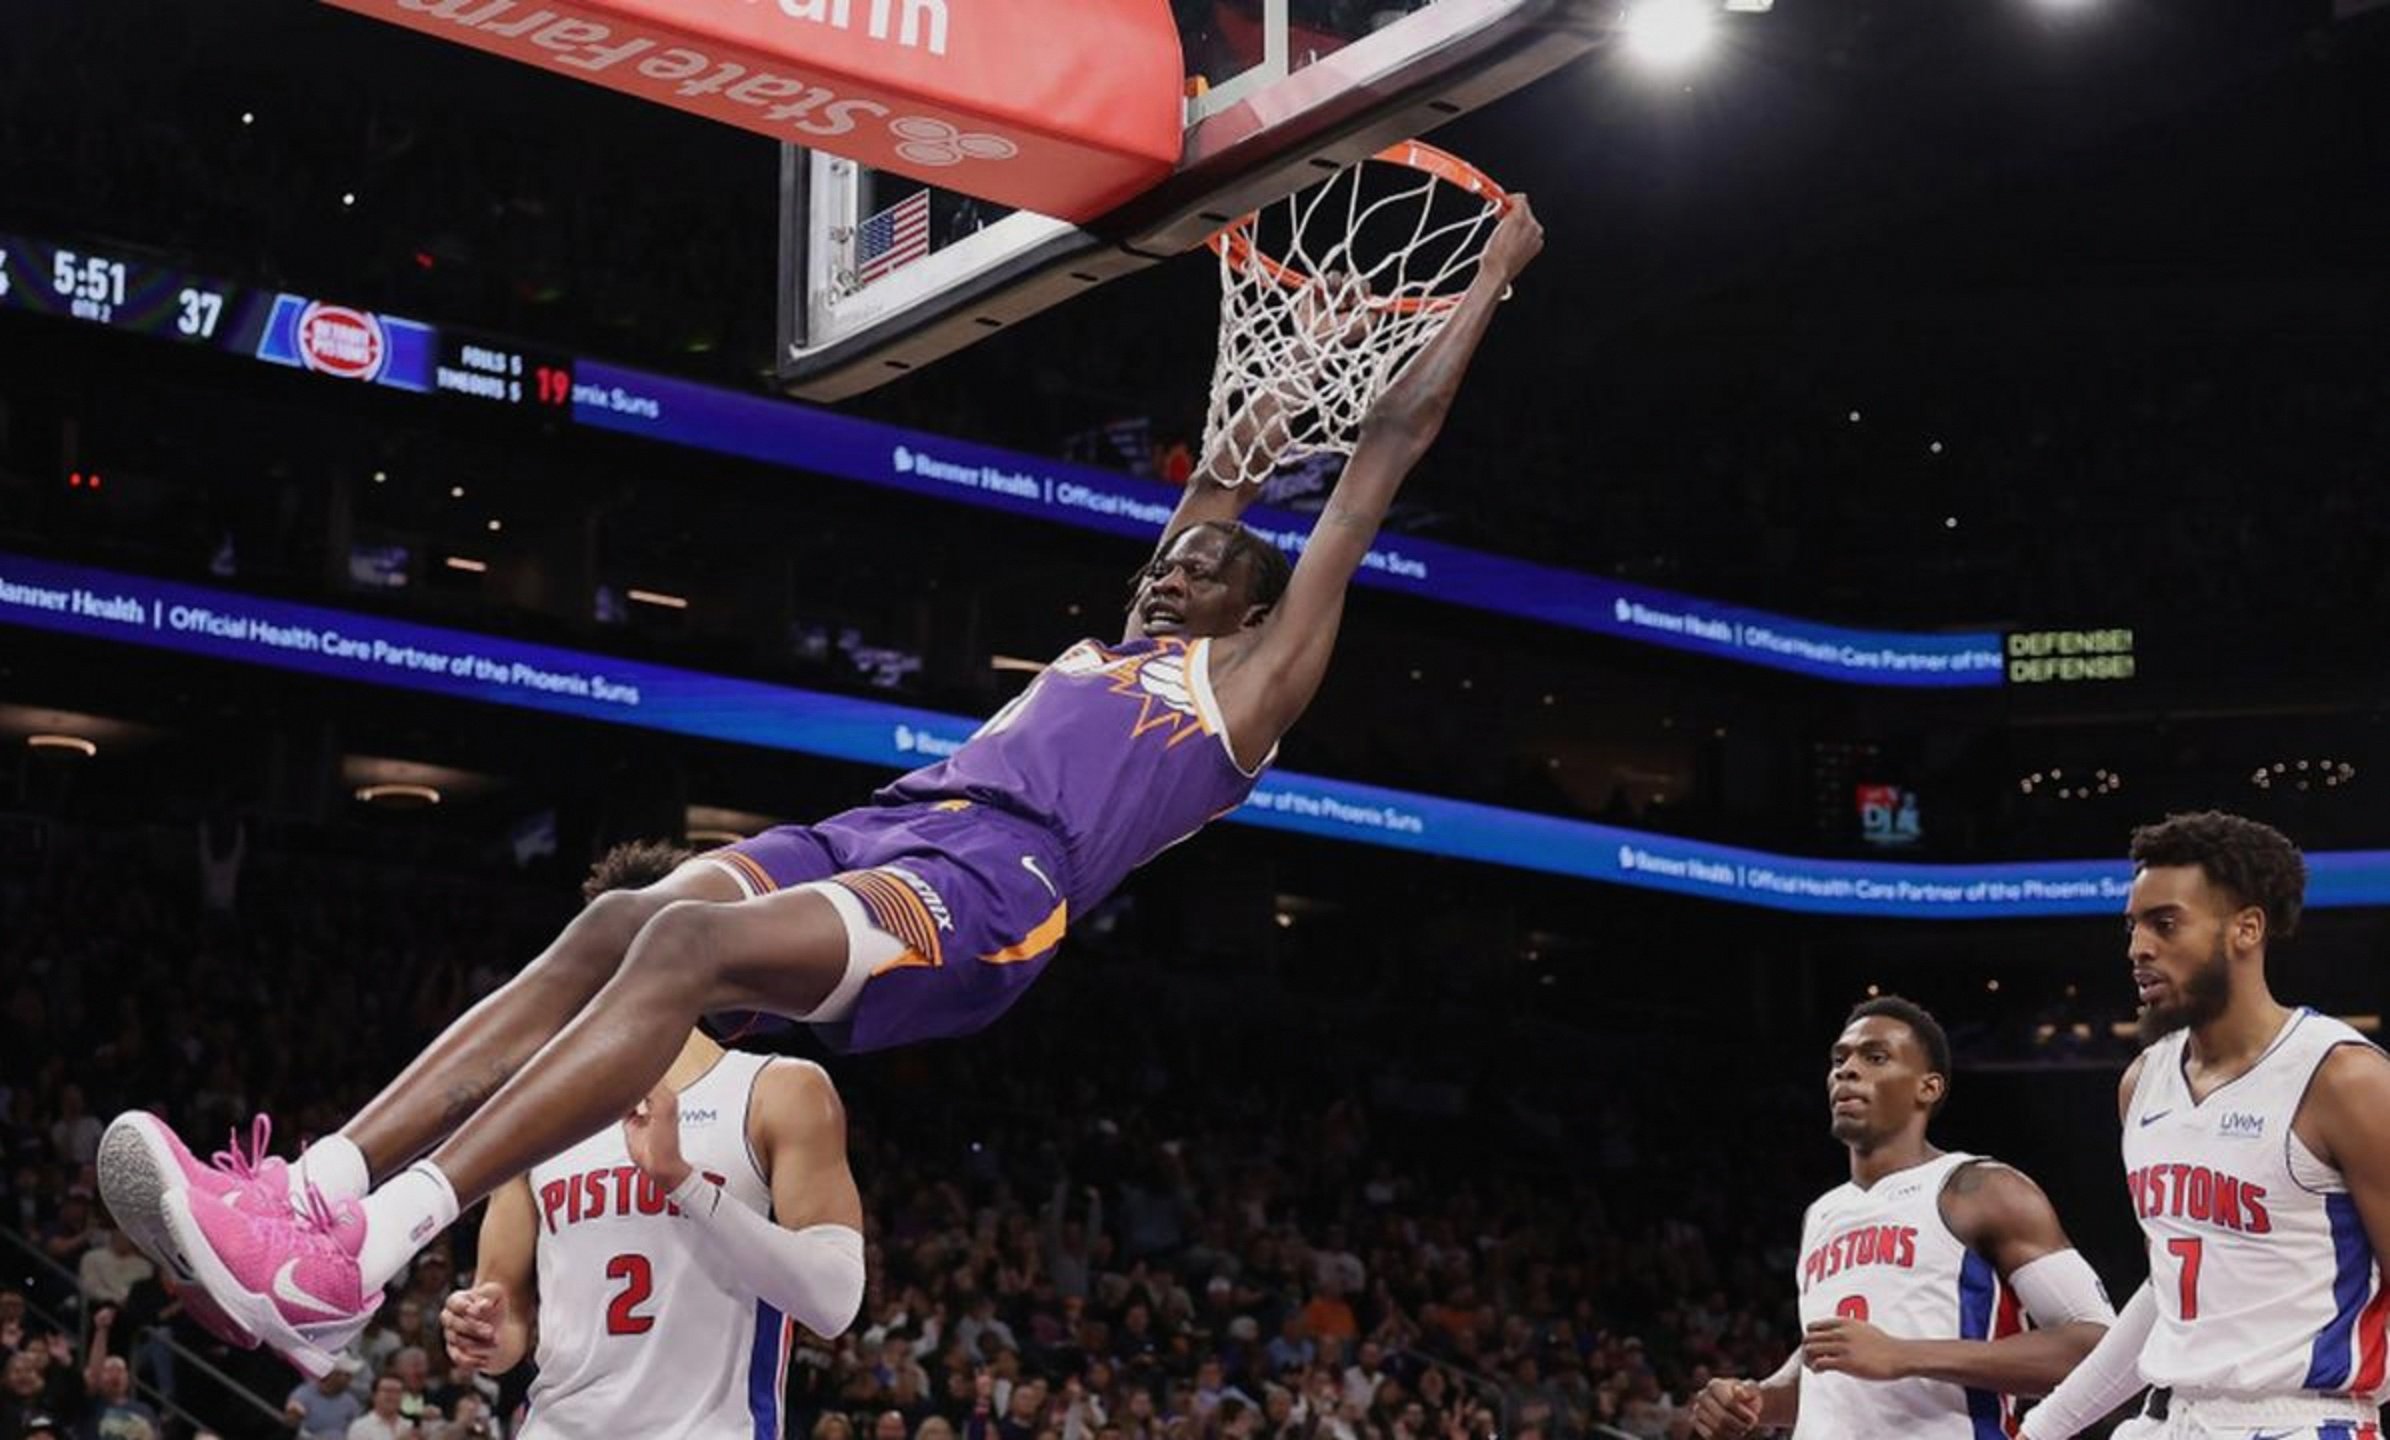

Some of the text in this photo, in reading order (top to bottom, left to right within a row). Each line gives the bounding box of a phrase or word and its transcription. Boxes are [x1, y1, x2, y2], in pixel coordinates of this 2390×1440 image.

[53, 249, 126, 306] 5:51
[177, 288, 223, 338] 37
[535, 366, 569, 405] 19
[611, 387, 659, 419] Suns
[915, 453, 978, 486] Banner
[980, 466, 1039, 498] Health
[1056, 482, 1117, 513] Official
[1387, 551, 1427, 579] Suns
[0, 578, 640, 705] anner Health Official Health Care Partner of the Phoenix Suns
[1632, 603, 1683, 632] Banner
[1685, 613, 1732, 642] Health
[1745, 625, 1793, 654] Official
[1794, 638, 1839, 663] Health
[1841, 646, 1879, 668] Care
[1881, 650, 1947, 672] Partner
[1949, 650, 1972, 671] of
[2008, 629, 2134, 657] DEFENSE!
[2009, 655, 2135, 682] DEFENSE!
[1275, 791, 1293, 812] of
[1293, 795, 1319, 817] the
[1321, 796, 1383, 826] Phoenix
[1384, 807, 1424, 834] Suns
[1635, 850, 1685, 875] Banner
[1687, 858, 1735, 885] Health
[1748, 868, 1797, 894] Official
[1799, 877, 1851, 897] Health
[1855, 879, 1895, 899] Care
[1898, 879, 1963, 901] Partner
[1965, 881, 1986, 902] of
[1988, 880, 2021, 901] the
[2023, 877, 2098, 899] Phoenix
[683, 1108, 718, 1122] WM
[2221, 1112, 2265, 1132] UWM
[540, 1165, 728, 1235] PISTO
[2127, 1163, 2272, 1234] PISTONS
[1804, 1225, 1919, 1295] PISTONS
[2167, 1237, 2203, 1321] 7
[606, 1253, 655, 1335] 2
